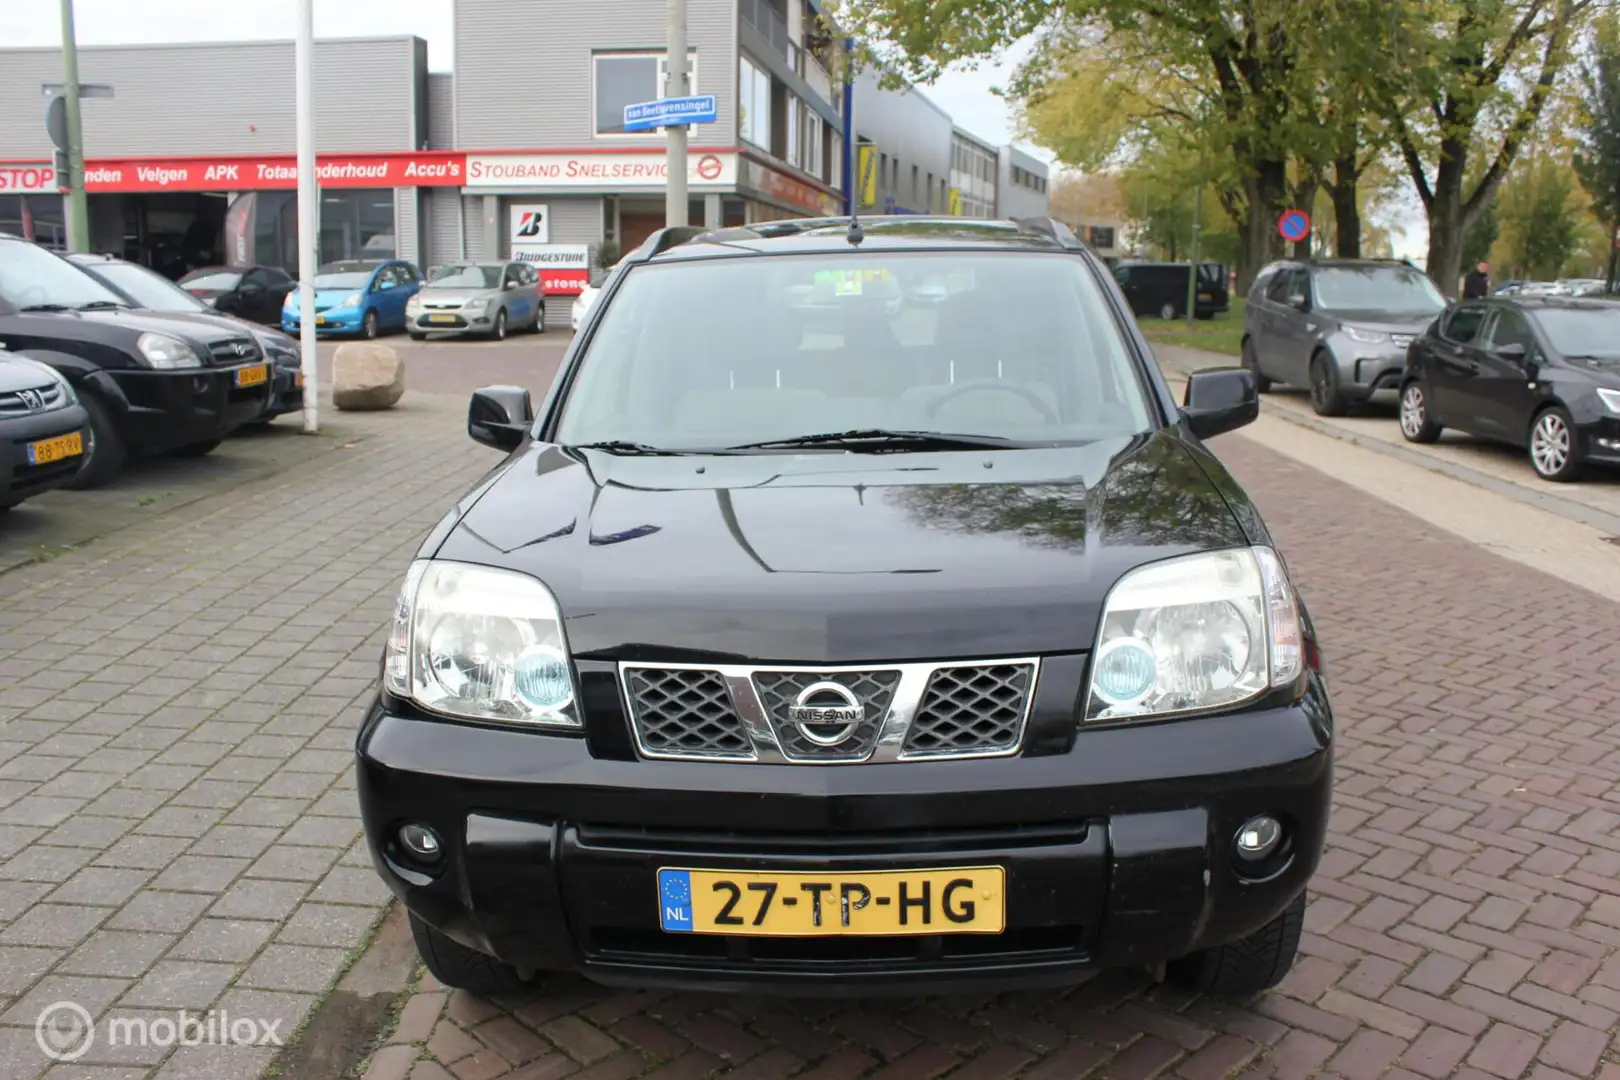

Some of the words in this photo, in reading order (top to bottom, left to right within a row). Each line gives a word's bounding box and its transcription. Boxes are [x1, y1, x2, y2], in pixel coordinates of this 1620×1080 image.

[84, 168, 122, 182] nden
[136, 167, 188, 185] Velgen
[204, 165, 239, 181] APK
[404, 161, 460, 177] Accu's
[565, 160, 669, 178] SNELSERVIC
[545, 278, 588, 289] stone
[796, 710, 857, 721] NISSAN
[711, 878, 976, 927] 27-TP-HG
[666, 907, 689, 921] NL
